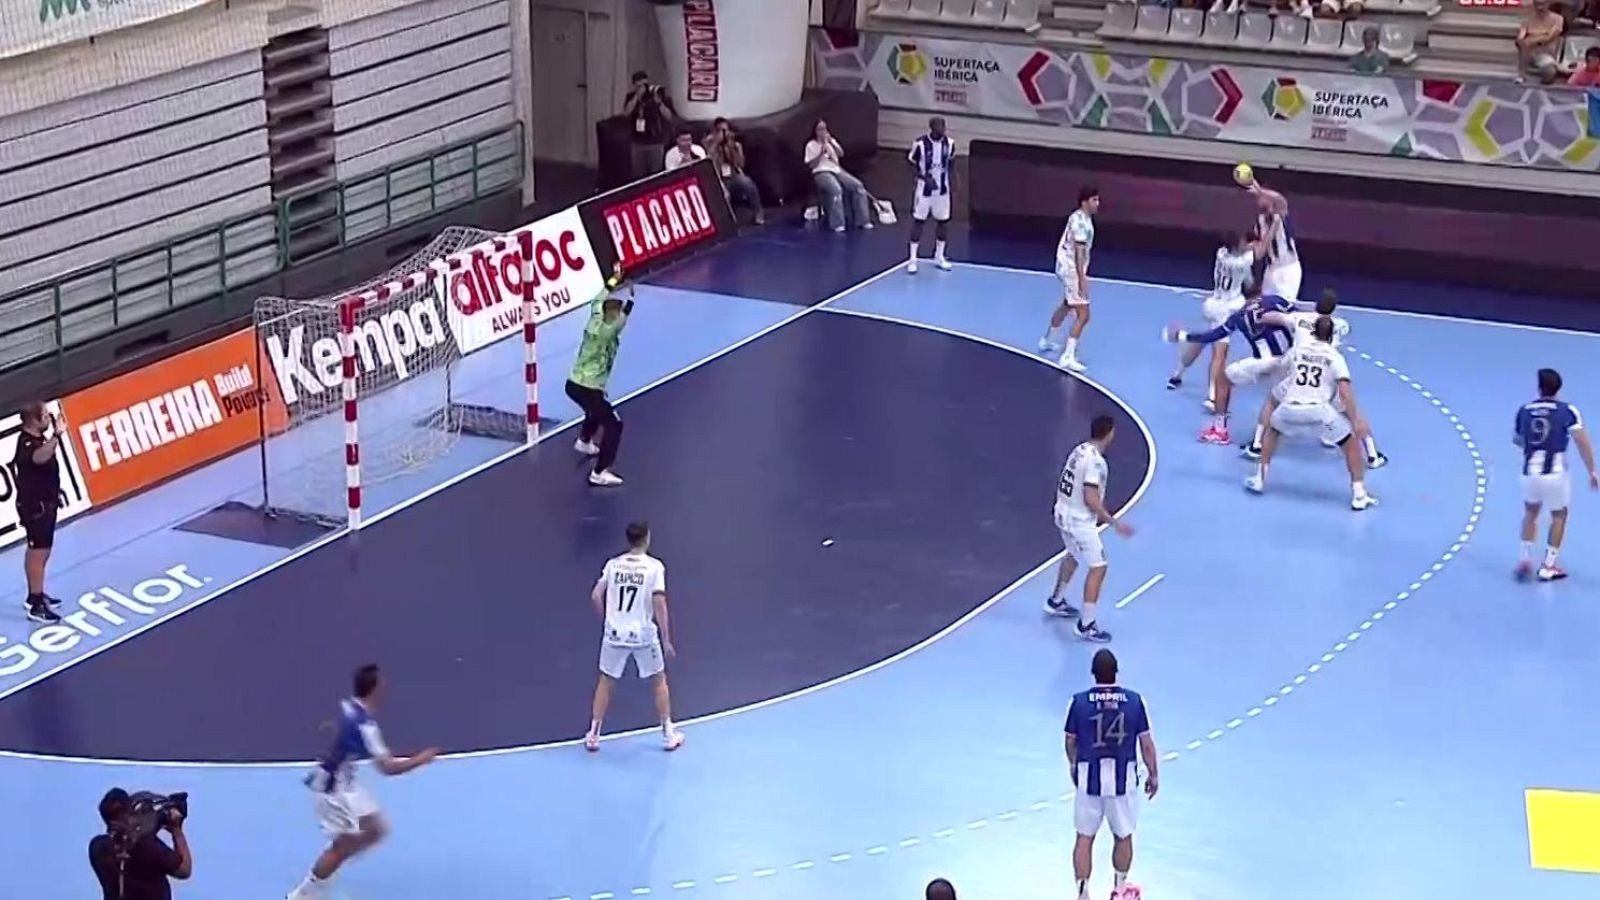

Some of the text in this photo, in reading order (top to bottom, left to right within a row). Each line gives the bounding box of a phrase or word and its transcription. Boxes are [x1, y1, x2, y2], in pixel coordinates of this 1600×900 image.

[934, 56, 1000, 73] SUPERTAÇA
[1314, 91, 1389, 109] SUPERTAÇA
[606, 184, 711, 261] PLACARD
[451, 230, 585, 316] alfaoc
[541, 287, 571, 312] YOU
[266, 297, 446, 405] Kempa
[214, 364, 253, 397] Build
[1296, 364, 1322, 388] 33
[79, 379, 223, 472] FERREIRA
[1528, 418, 1551, 446] 9
[618, 586, 638, 612] 17
[1089, 693, 1128, 702] EMPRIL
[1088, 712, 1127, 748] 14
